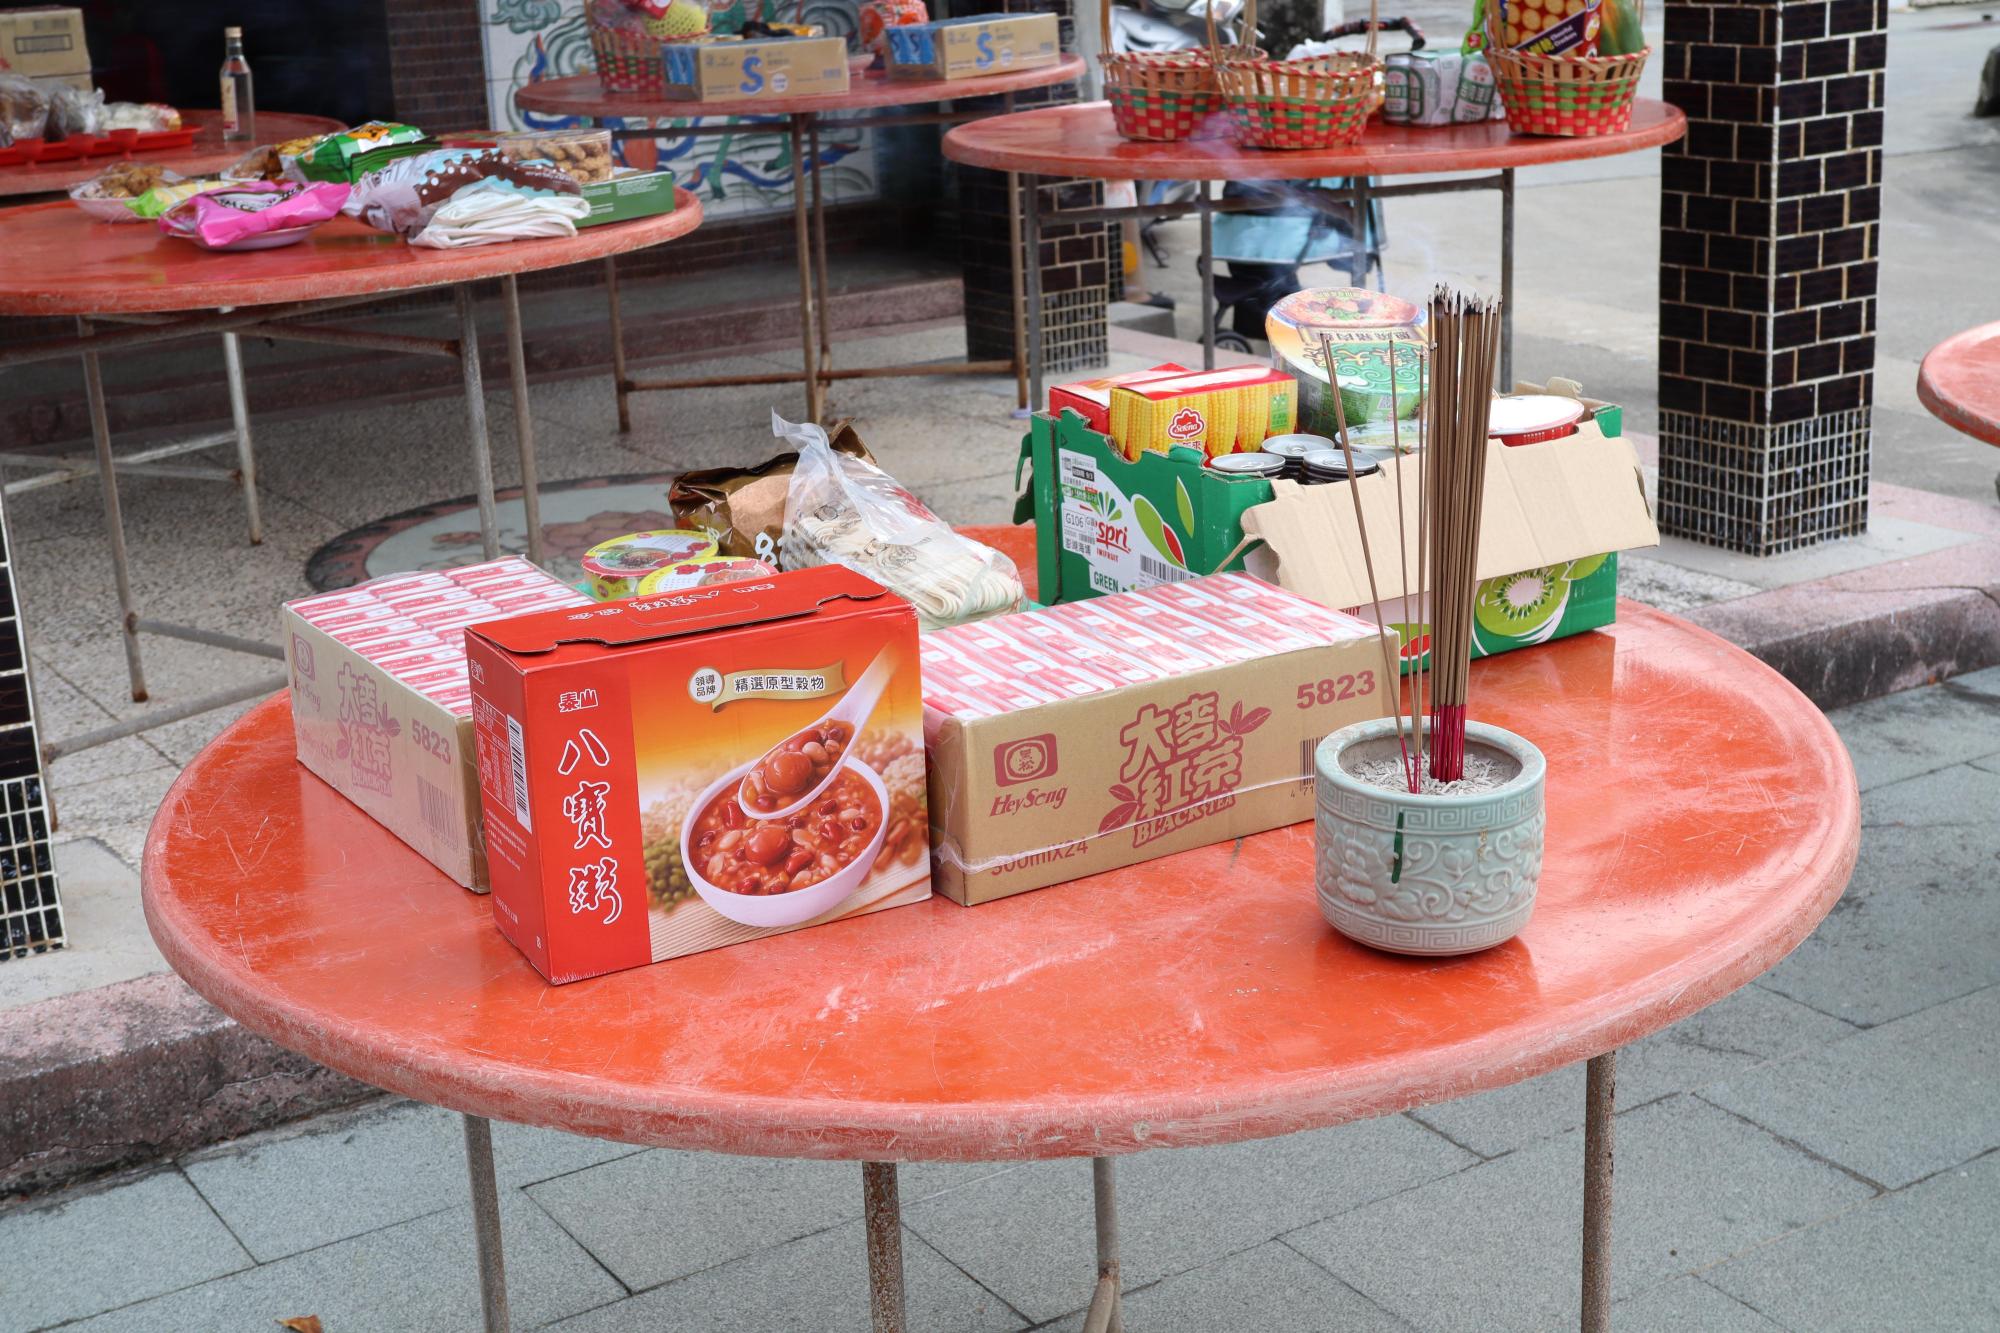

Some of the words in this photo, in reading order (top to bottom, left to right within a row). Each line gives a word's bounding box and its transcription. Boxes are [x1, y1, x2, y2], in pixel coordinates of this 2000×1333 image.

[740, 55, 764, 95] S
[1094, 571, 1119, 593] GREEN
[695, 674, 715, 686] 領導
[696, 686, 716, 698] 品牌
[734, 675, 825, 693] 精選原型穀物
[1297, 670, 1375, 709] 5823
[558, 688, 599, 713] 泰山
[411, 718, 452, 765] 5823
[1120, 691, 1219, 783] 大麥
[1137, 735, 1242, 822] 紅茶
[990, 784, 1069, 817] HeySong
[557, 728, 623, 925] 八寶粥
[1134, 806, 1204, 847] BLACK
[1206, 794, 1236, 816] TEA
